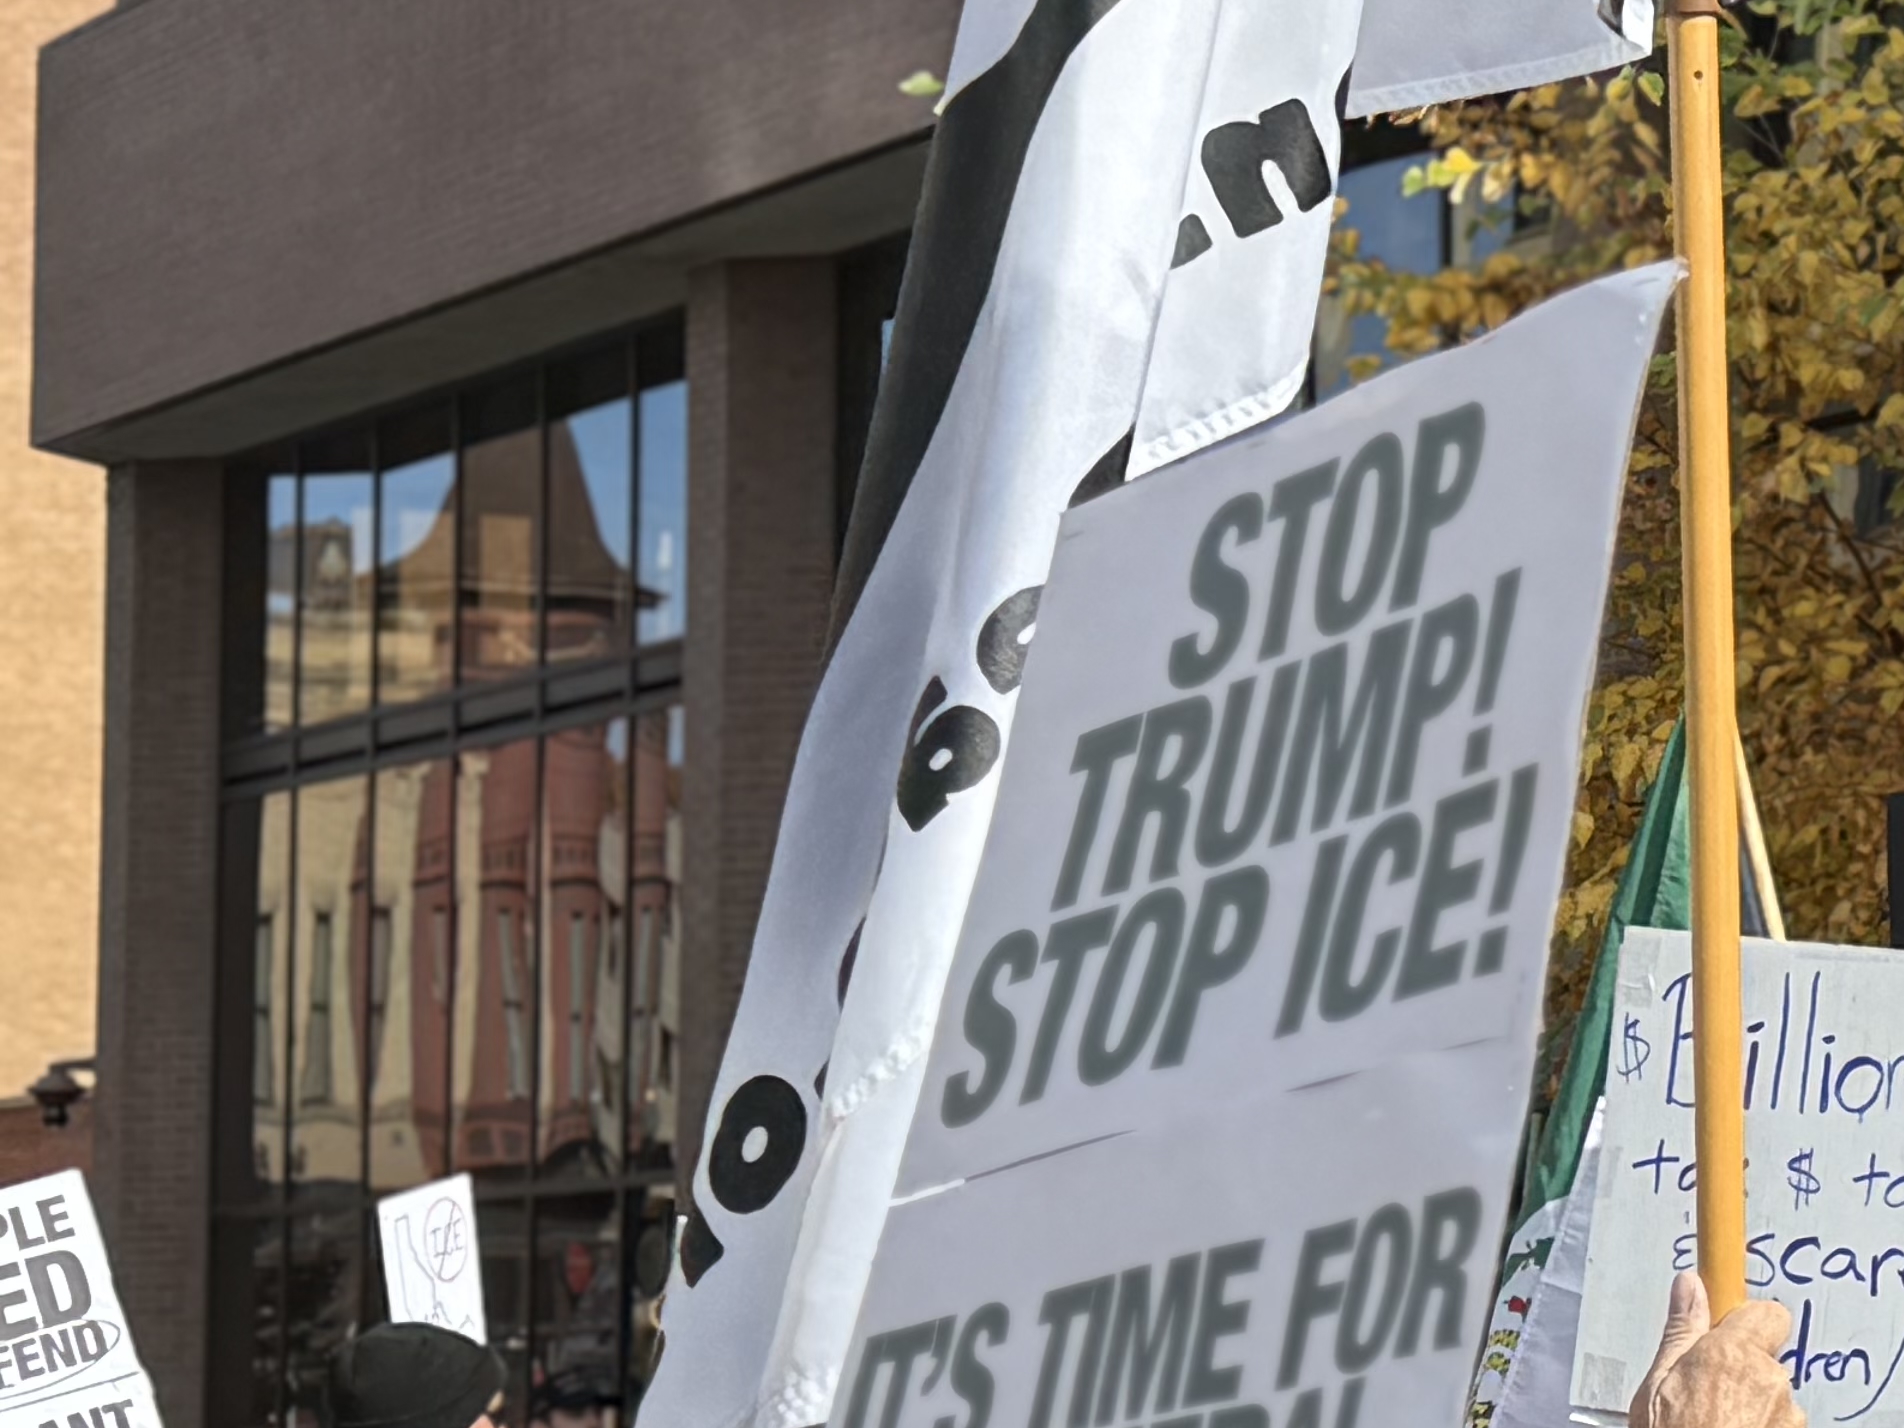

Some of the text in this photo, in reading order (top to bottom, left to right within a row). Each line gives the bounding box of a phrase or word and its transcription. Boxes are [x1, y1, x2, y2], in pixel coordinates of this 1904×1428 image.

[1167, 400, 1486, 691] STOP
[1050, 566, 1523, 913] TRUMP!
[939, 762, 1537, 1129] STOP ICE!
[1274, 1184, 1485, 1390] FOR
[1786, 1147, 1821, 1211] $
